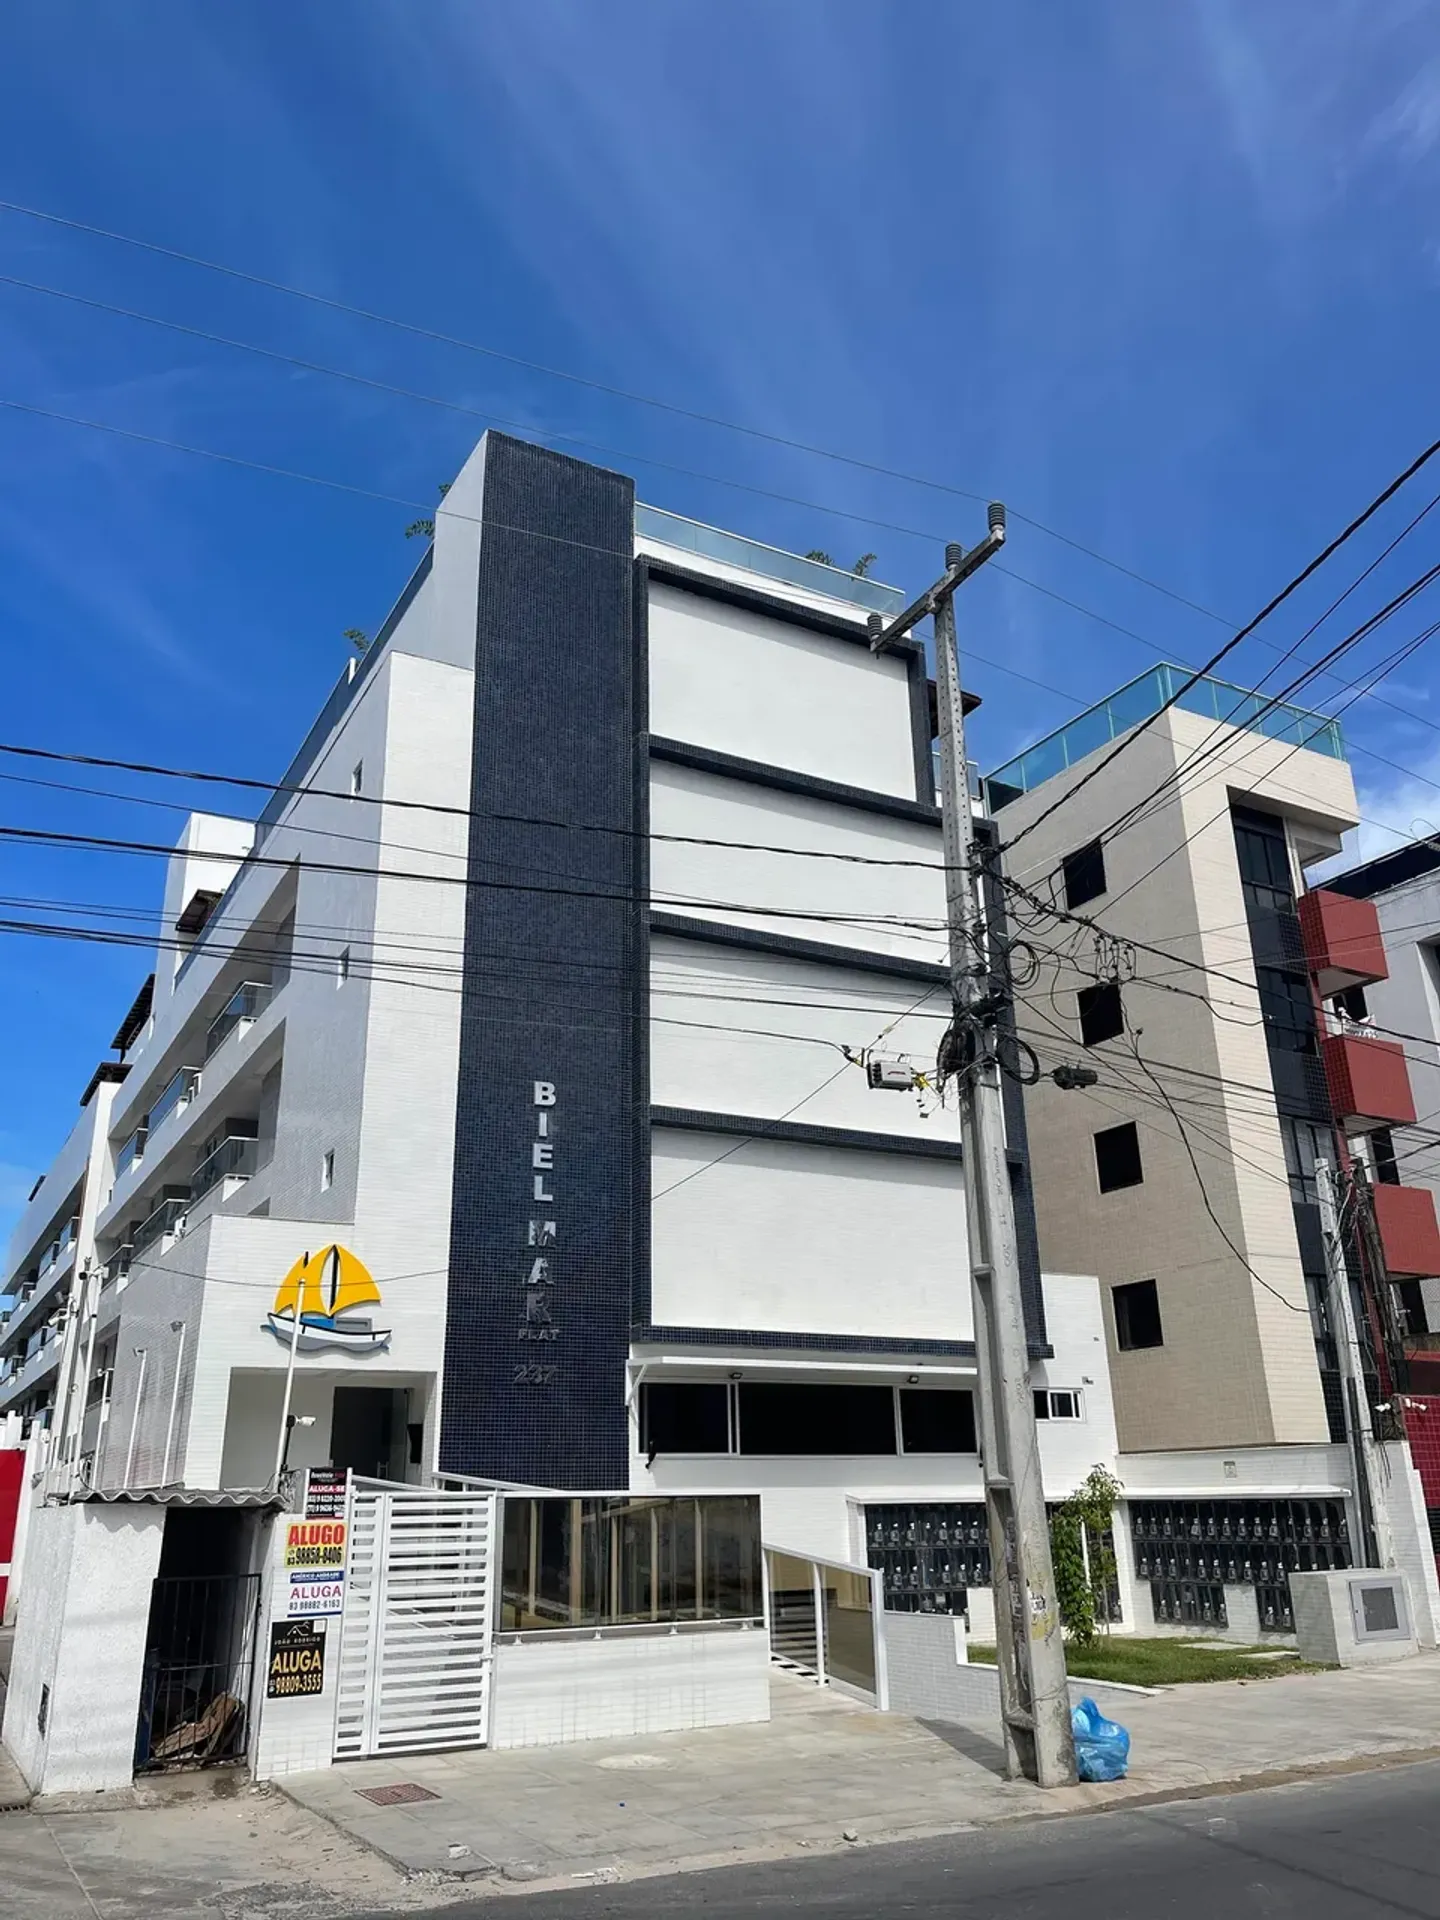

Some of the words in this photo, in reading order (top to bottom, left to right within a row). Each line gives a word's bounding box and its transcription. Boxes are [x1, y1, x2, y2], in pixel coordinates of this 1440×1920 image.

[518, 1328, 561, 1341] FLAT
[288, 1524, 345, 1546] ALUGO
[291, 1585, 342, 1599] ALUGA
[271, 1649, 322, 1674] ALUGA
